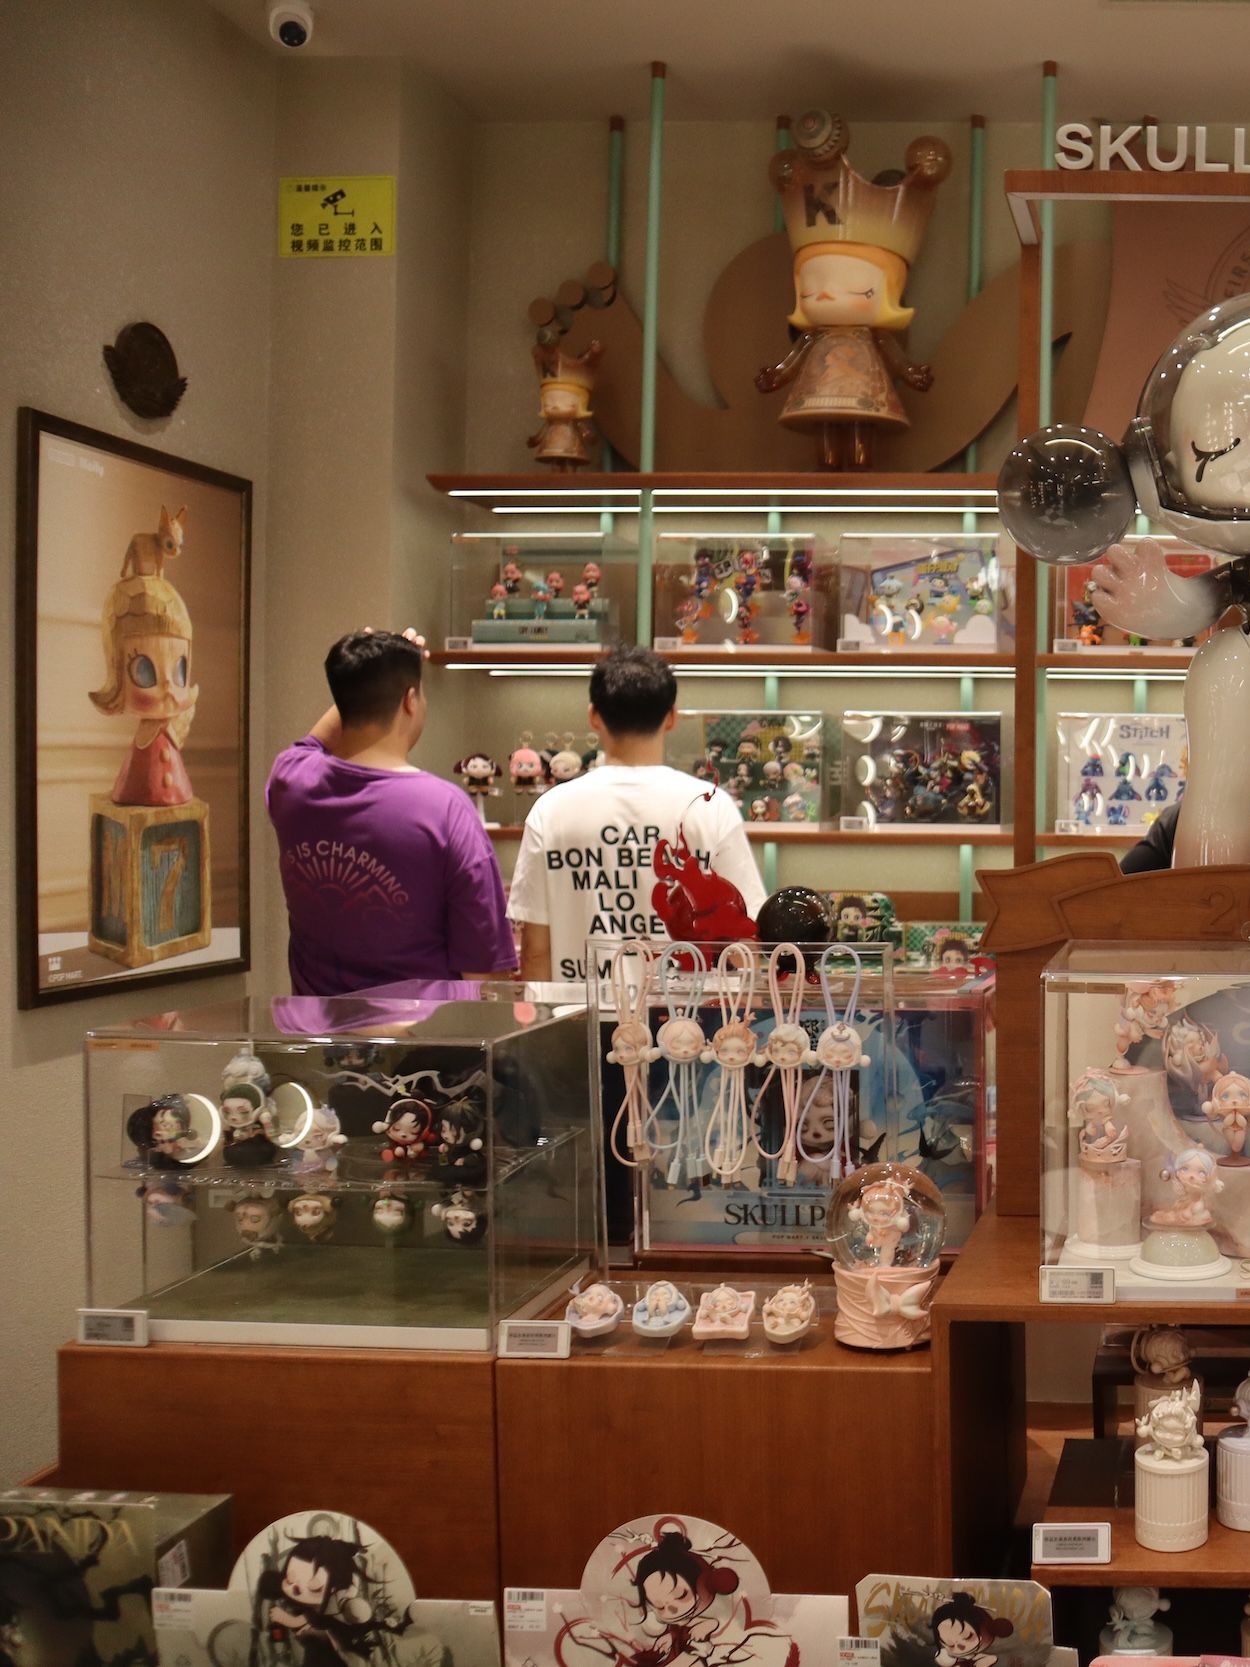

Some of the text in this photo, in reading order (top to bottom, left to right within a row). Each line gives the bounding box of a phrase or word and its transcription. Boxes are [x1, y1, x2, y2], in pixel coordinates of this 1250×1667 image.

[290, 222, 382, 236] 您已进入
[290, 238, 383, 252] 视频监控范围
[600, 825, 660, 845] CAR
[547, 848, 711, 870] BON BEH
[316, 840, 409, 906] CHARMING
[572, 870, 638, 891] MALI
[598, 892, 636, 912] LO
[724, 1203, 827, 1227] SKULLP
